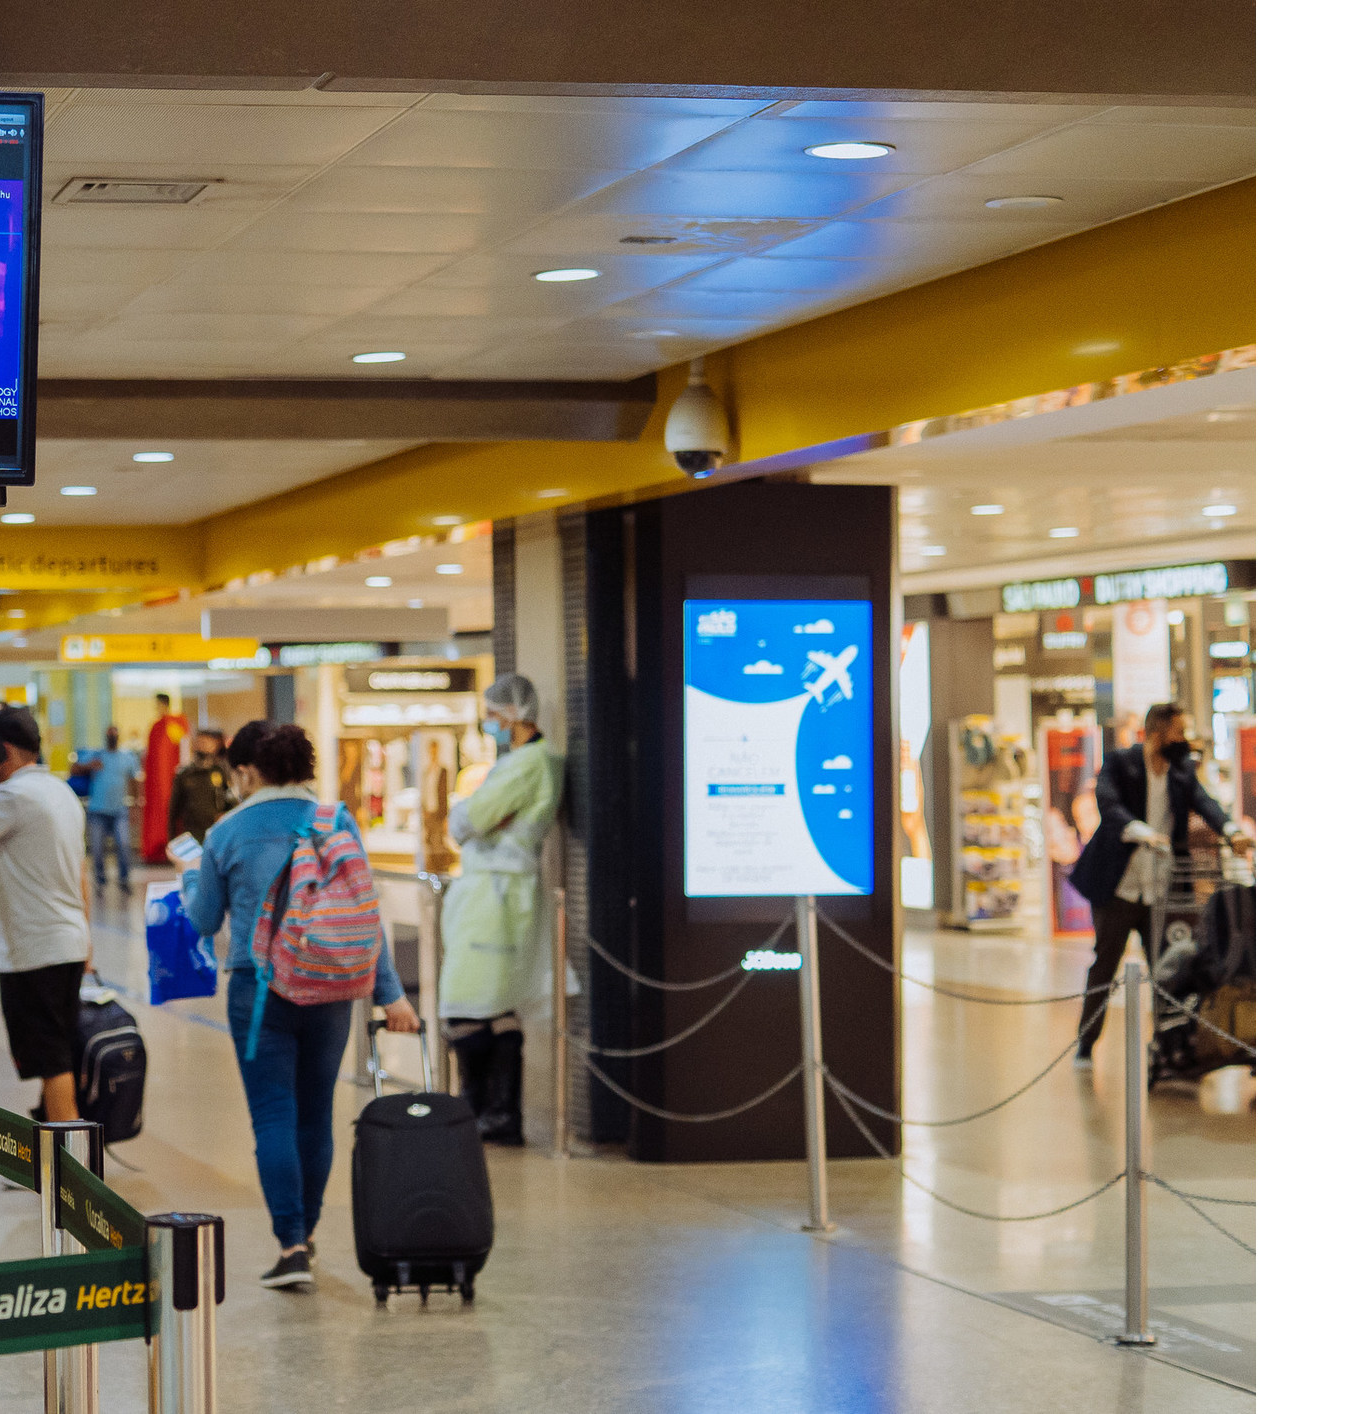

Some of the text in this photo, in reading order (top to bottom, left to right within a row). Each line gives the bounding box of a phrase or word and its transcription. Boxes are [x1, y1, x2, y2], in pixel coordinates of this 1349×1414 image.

[29, 552, 160, 578] departures
[18, 1141, 32, 1163] Hertz
[76, 1280, 145, 1311] Hertz
